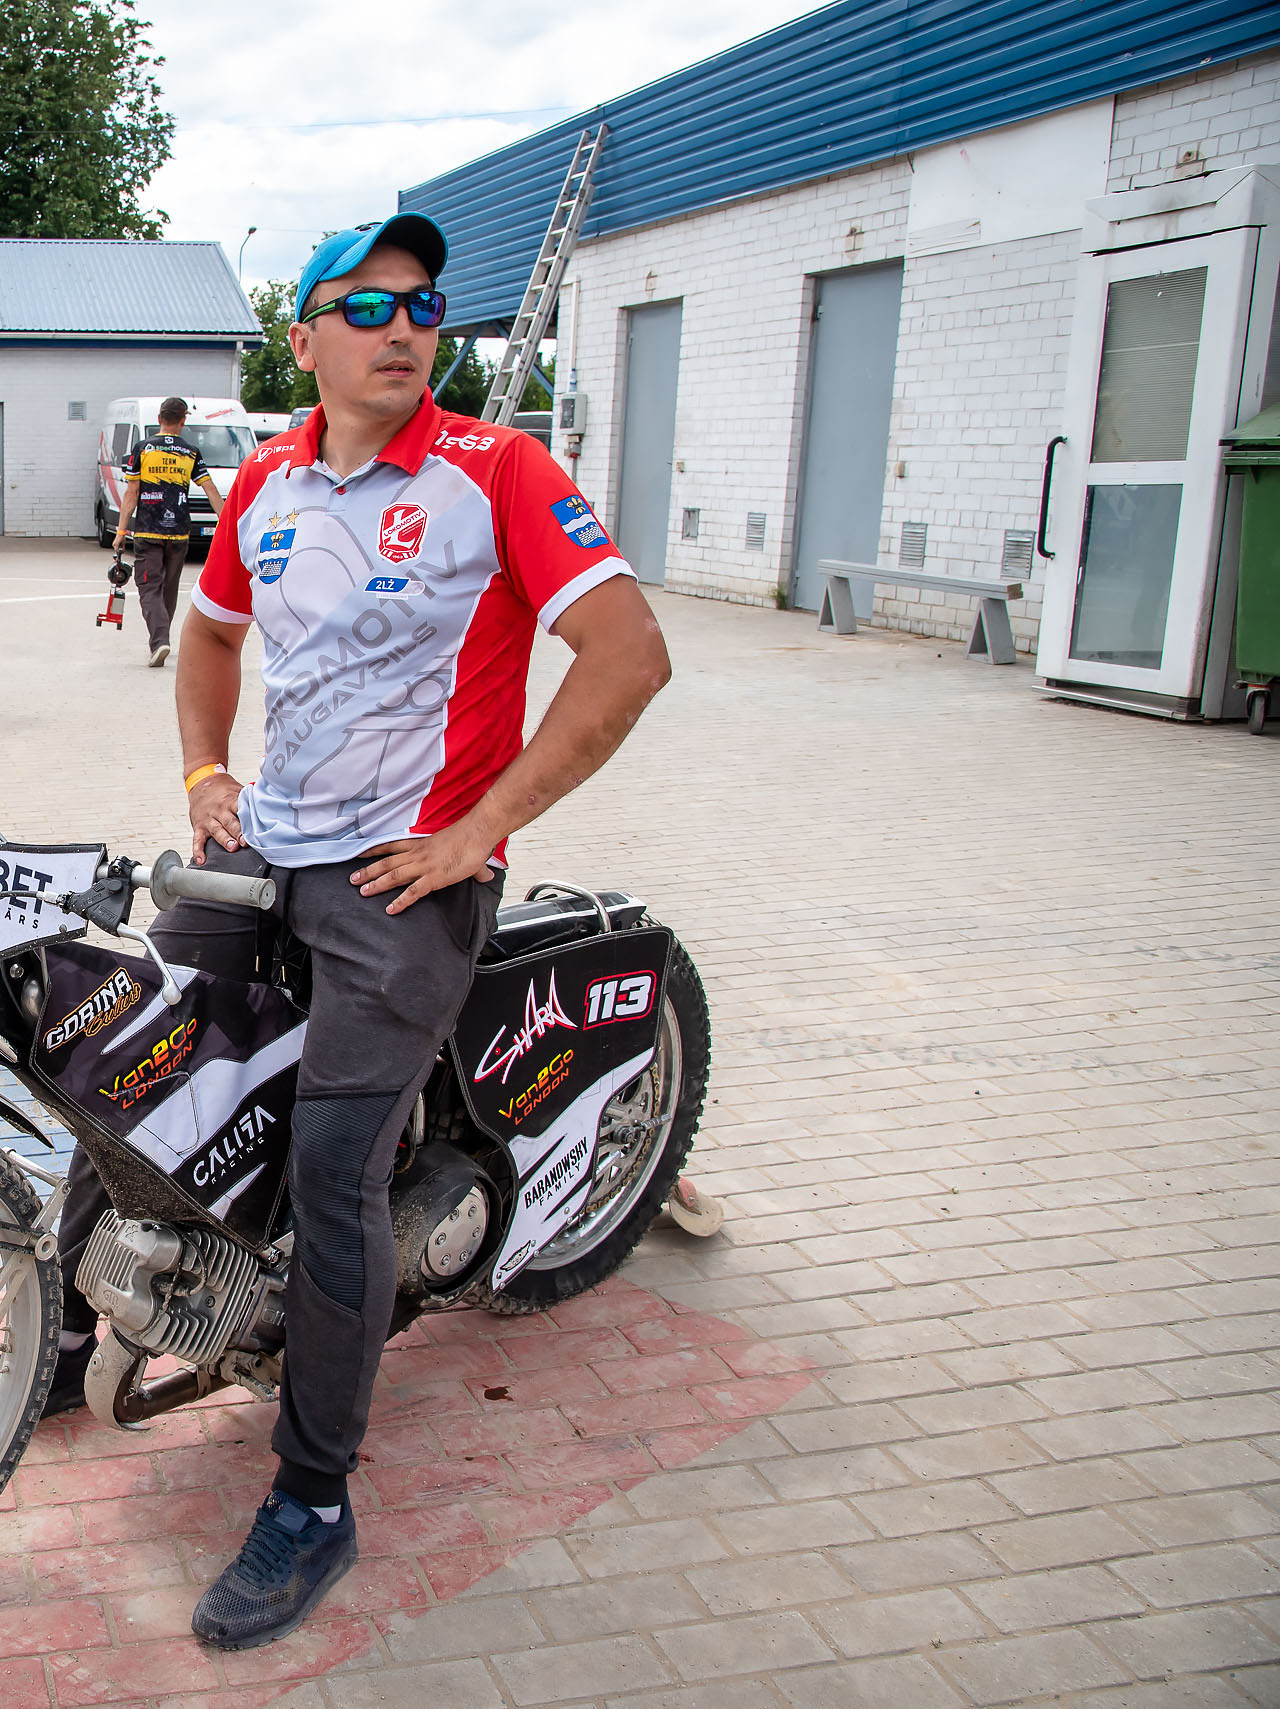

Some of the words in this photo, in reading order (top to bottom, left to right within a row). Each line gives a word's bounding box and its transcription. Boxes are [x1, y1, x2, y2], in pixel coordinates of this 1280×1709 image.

[383, 511, 422, 537] LOKOMOTIV
[265, 540, 458, 754] OKOMOTIV
[272, 620, 437, 775] DAUGAVPILS
[587, 975, 653, 1024] 113
[122, 1039, 193, 1111] LONDON
[513, 1066, 570, 1126] LONDON
[211, 1137, 265, 1185] RACING
[538, 1164, 581, 1207] FAMILY
